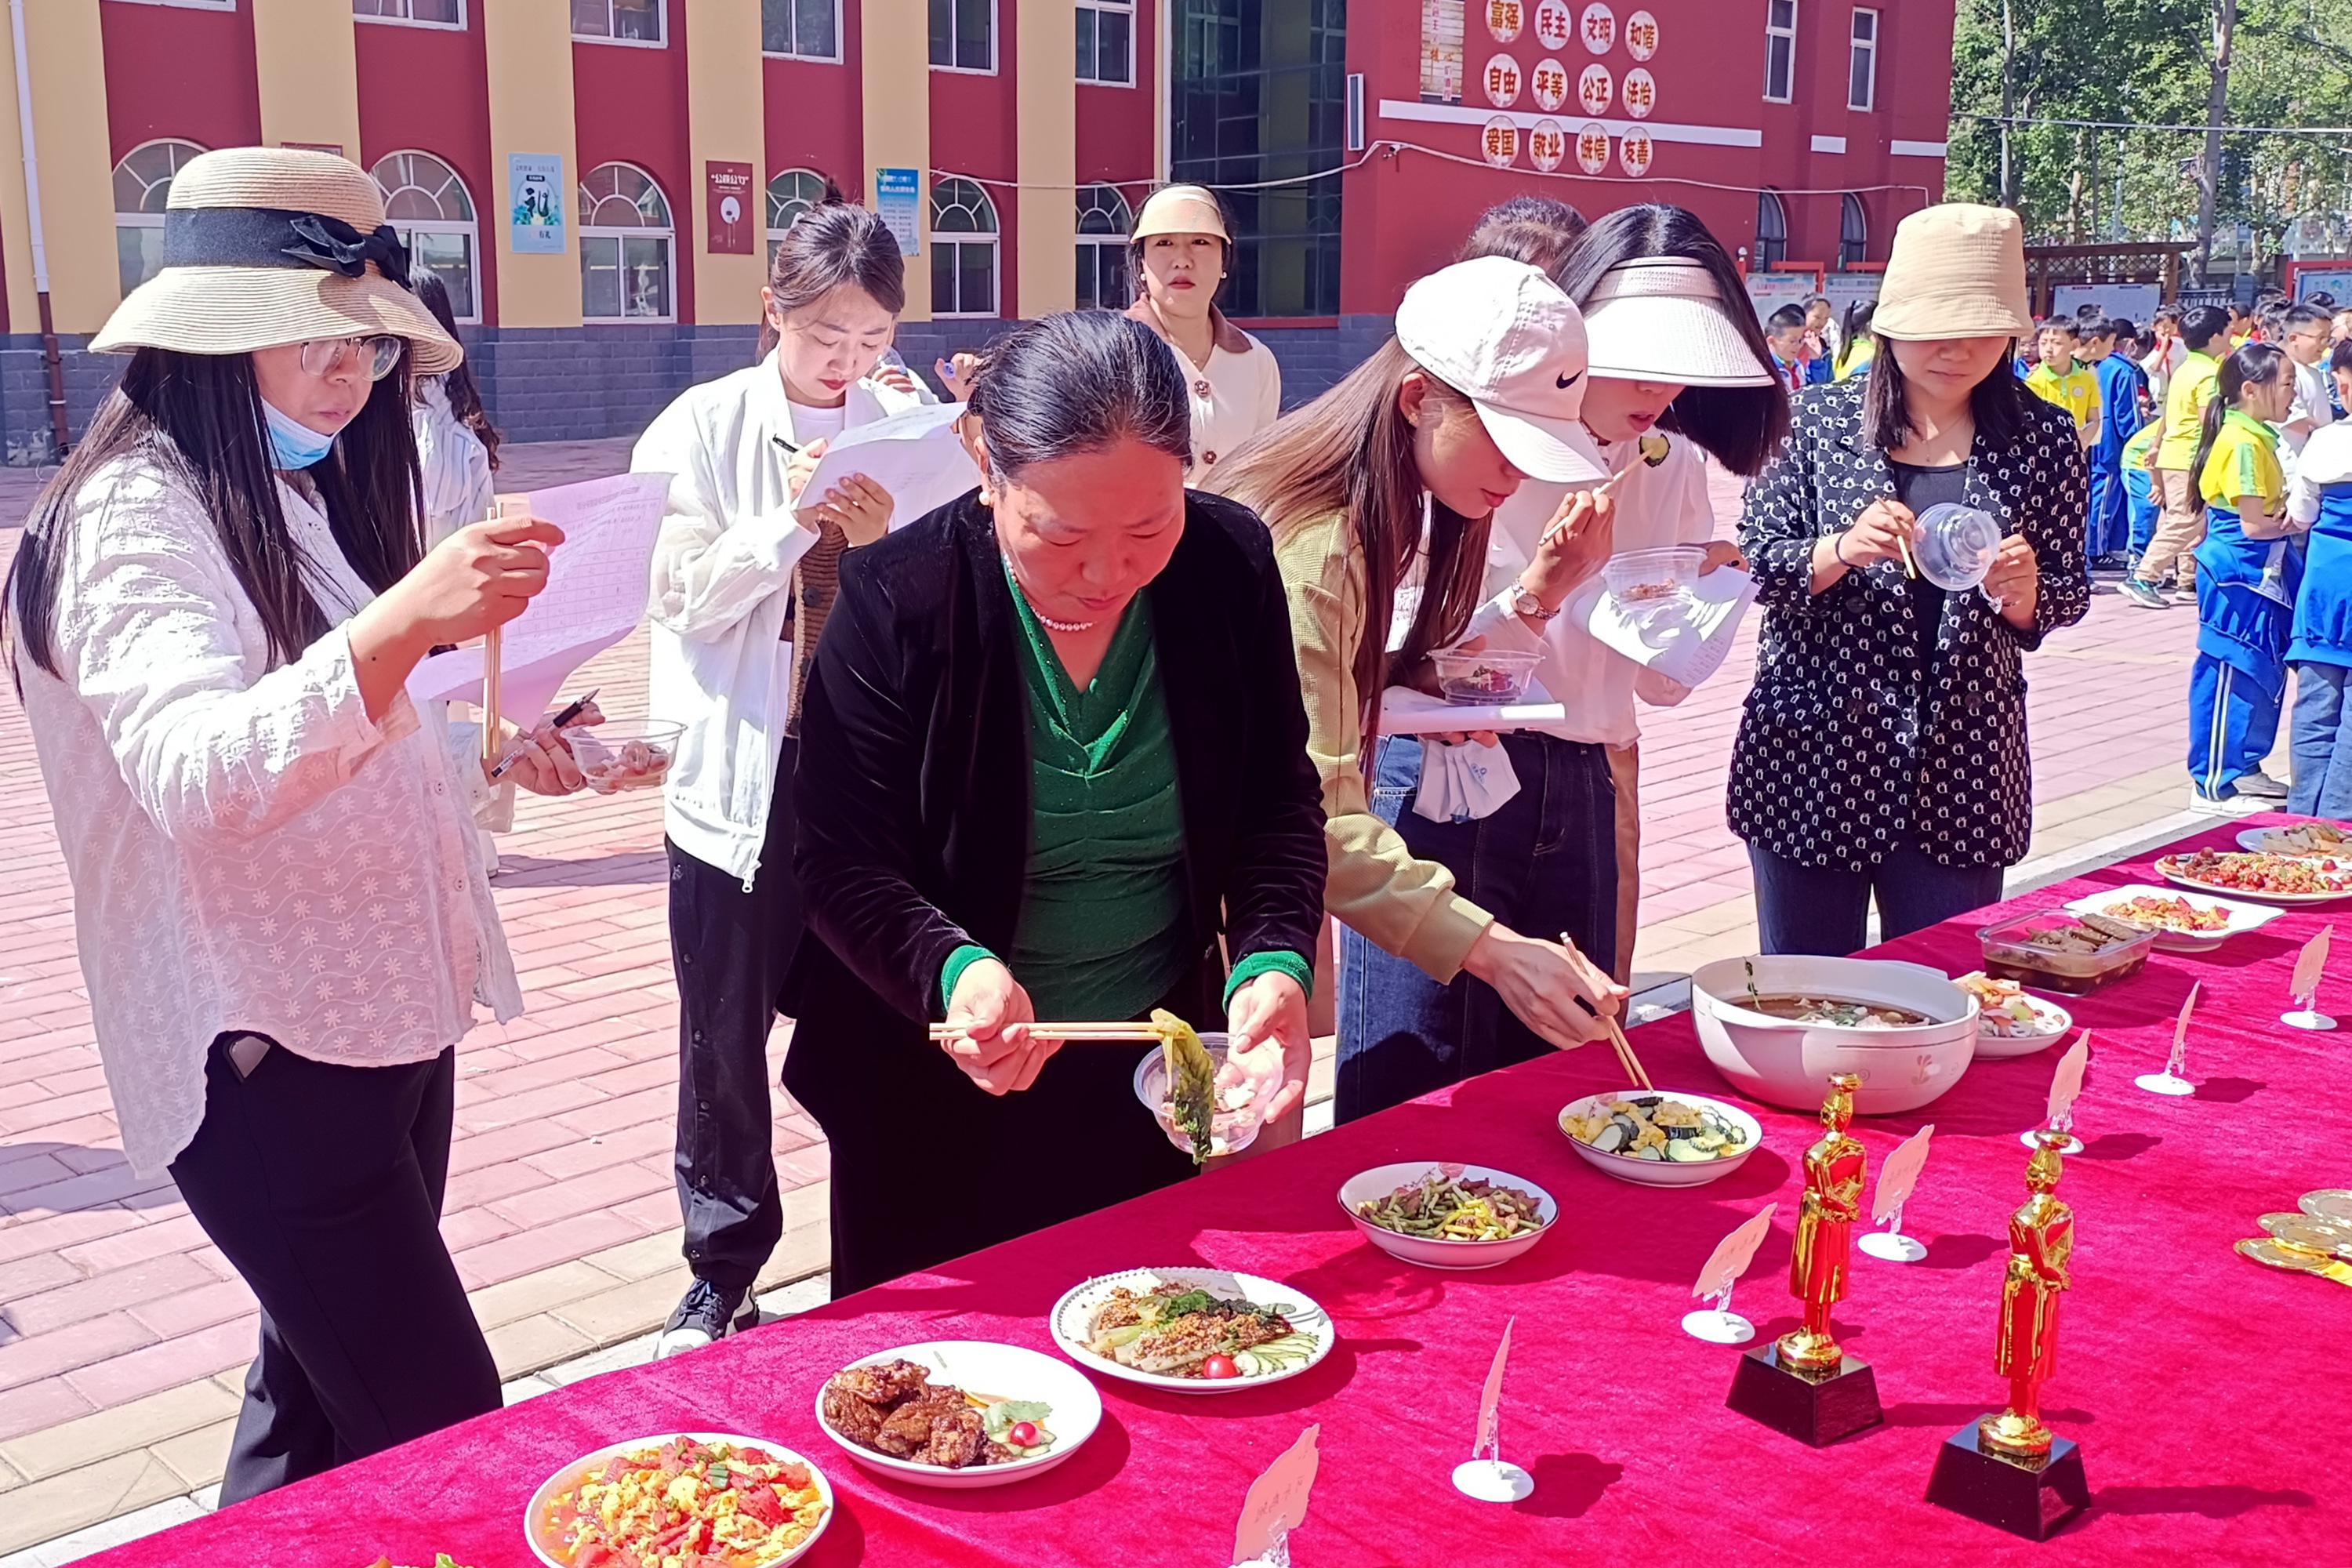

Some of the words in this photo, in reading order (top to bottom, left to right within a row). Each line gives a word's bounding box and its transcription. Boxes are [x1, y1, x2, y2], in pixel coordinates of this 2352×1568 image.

[1490, 0, 1519, 30] 富强
[1541, 9, 1566, 38] 民主
[1586, 13, 1611, 42] 文明
[1630, 21, 1655, 49] 和谐
[1490, 66, 1516, 94] 自由
[1537, 71, 1563, 98] 平等
[1583, 75, 1607, 102] 公正
[1627, 79, 1651, 105] 法治
[1486, 128, 1515, 156] 爱国
[1534, 131, 1561, 158] 敬业
[1581, 135, 1606, 162] 诚信
[1624, 139, 1649, 165] 友善
